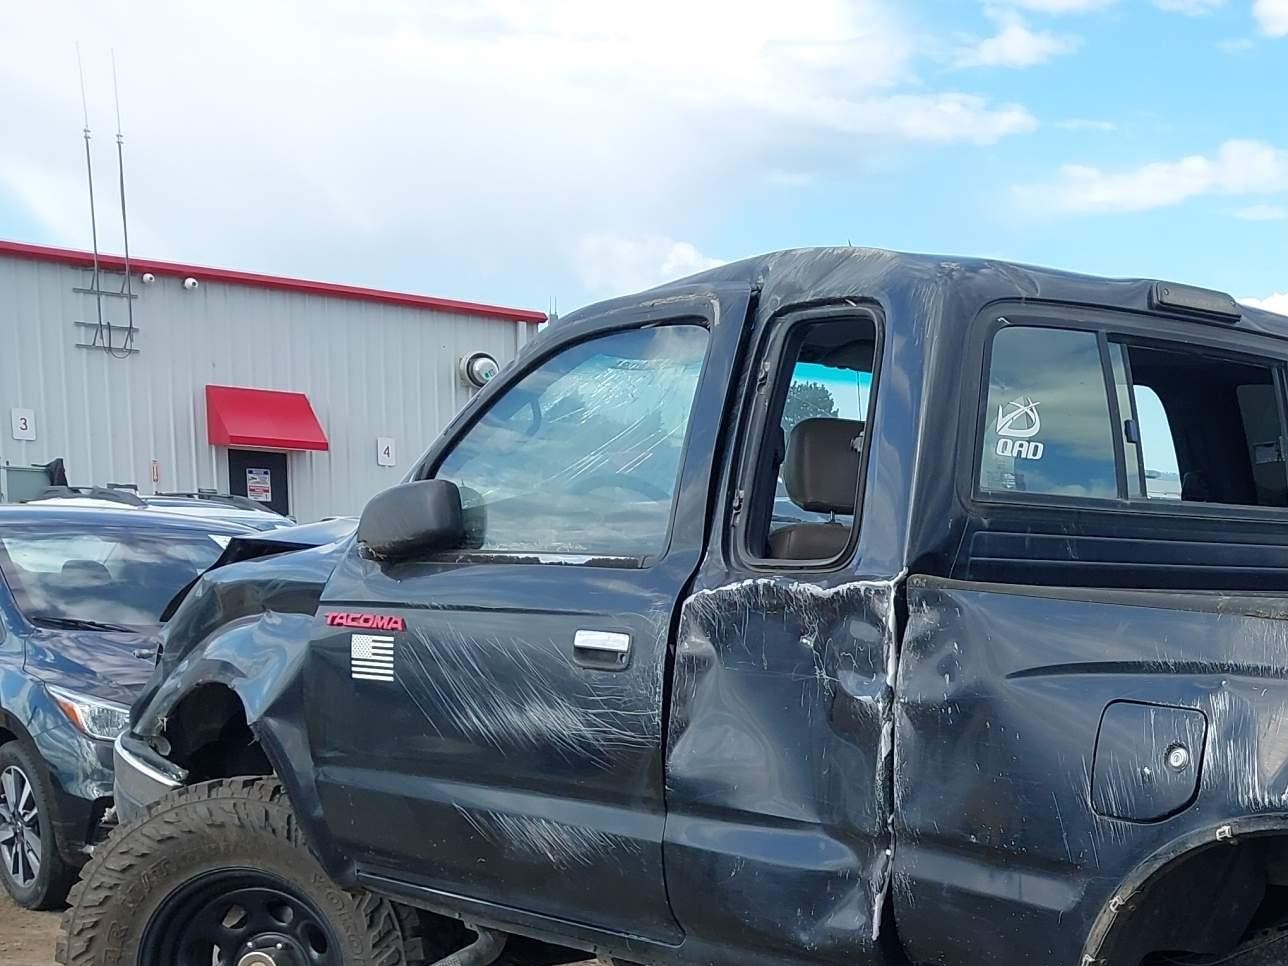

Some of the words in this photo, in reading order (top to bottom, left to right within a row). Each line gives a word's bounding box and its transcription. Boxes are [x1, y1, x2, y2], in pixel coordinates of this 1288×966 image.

[19, 417, 28, 431] 3
[383, 445, 390, 458] 4
[996, 438, 1044, 460] QAD
[325, 612, 407, 632] TACOMA
